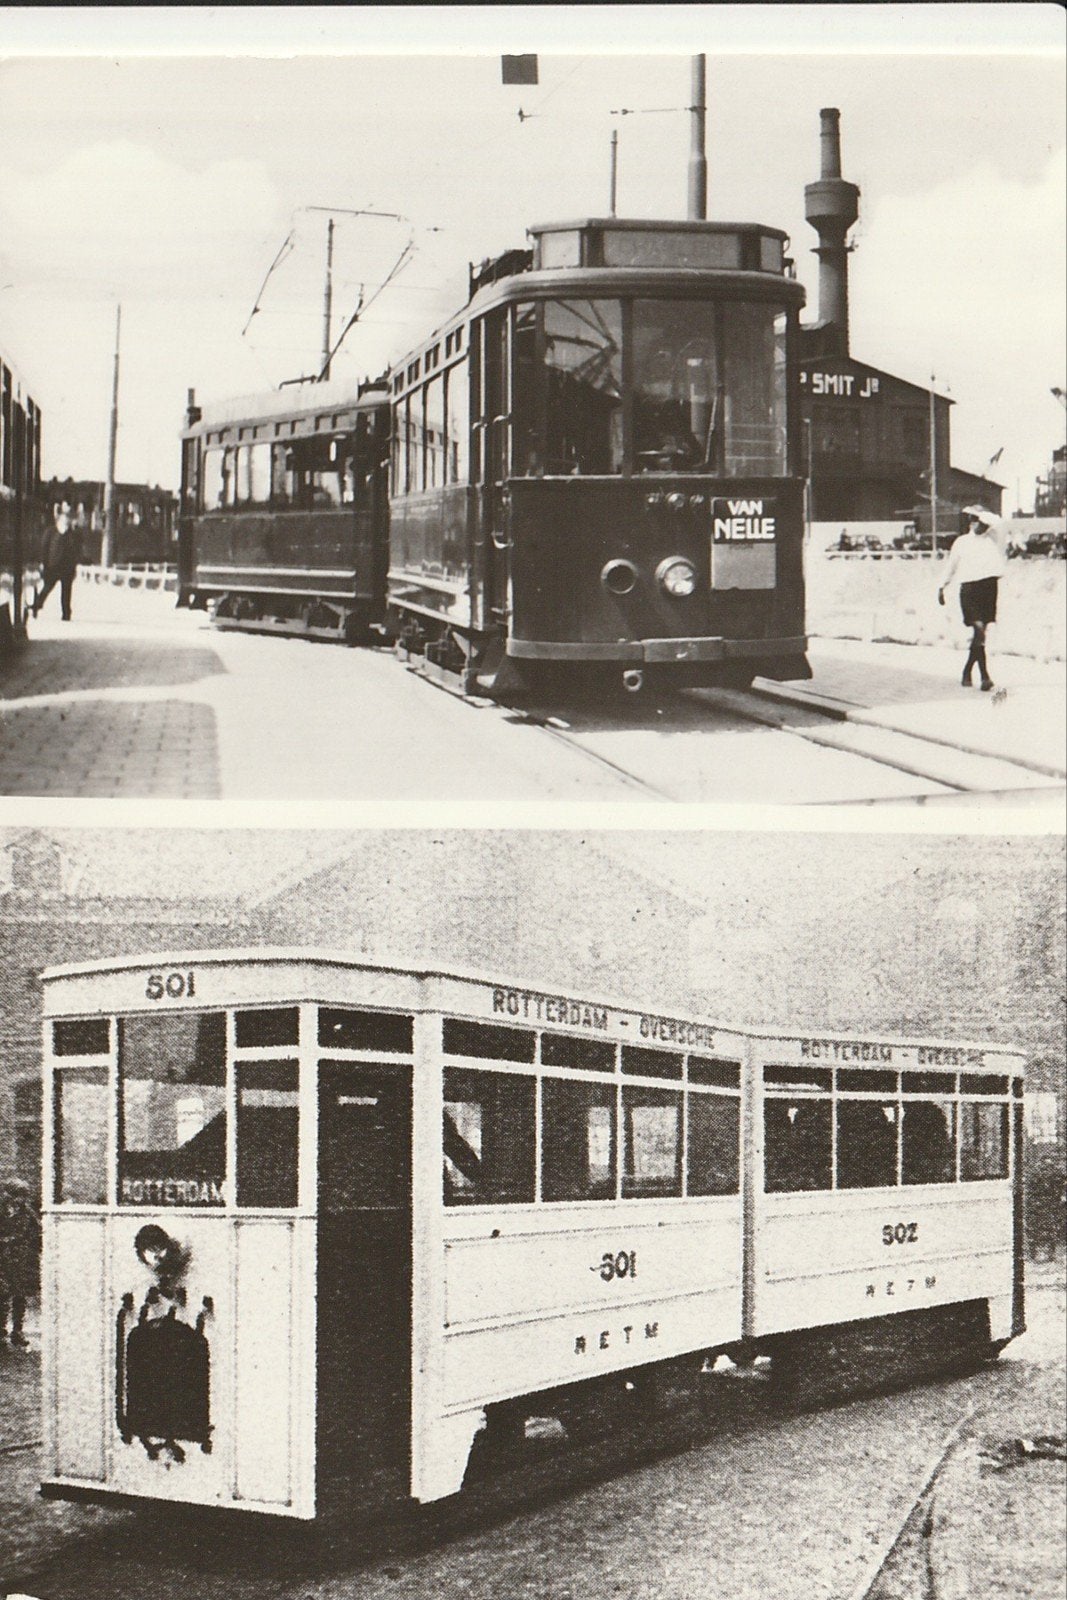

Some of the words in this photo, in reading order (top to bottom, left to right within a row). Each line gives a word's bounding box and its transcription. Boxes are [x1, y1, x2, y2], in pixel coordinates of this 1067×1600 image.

[812, 372, 855, 396] SMIT
[727, 500, 763, 516] VAN
[714, 518, 776, 540] NELLE
[492, 988, 609, 1031] ROTTERDAM
[639, 1014, 715, 1050] OVERSCHIE
[801, 1039, 893, 1062] ROTTERDAM
[917, 1046, 986, 1068] OVERSCHIE
[121, 1178, 224, 1203] ROTTERDAM
